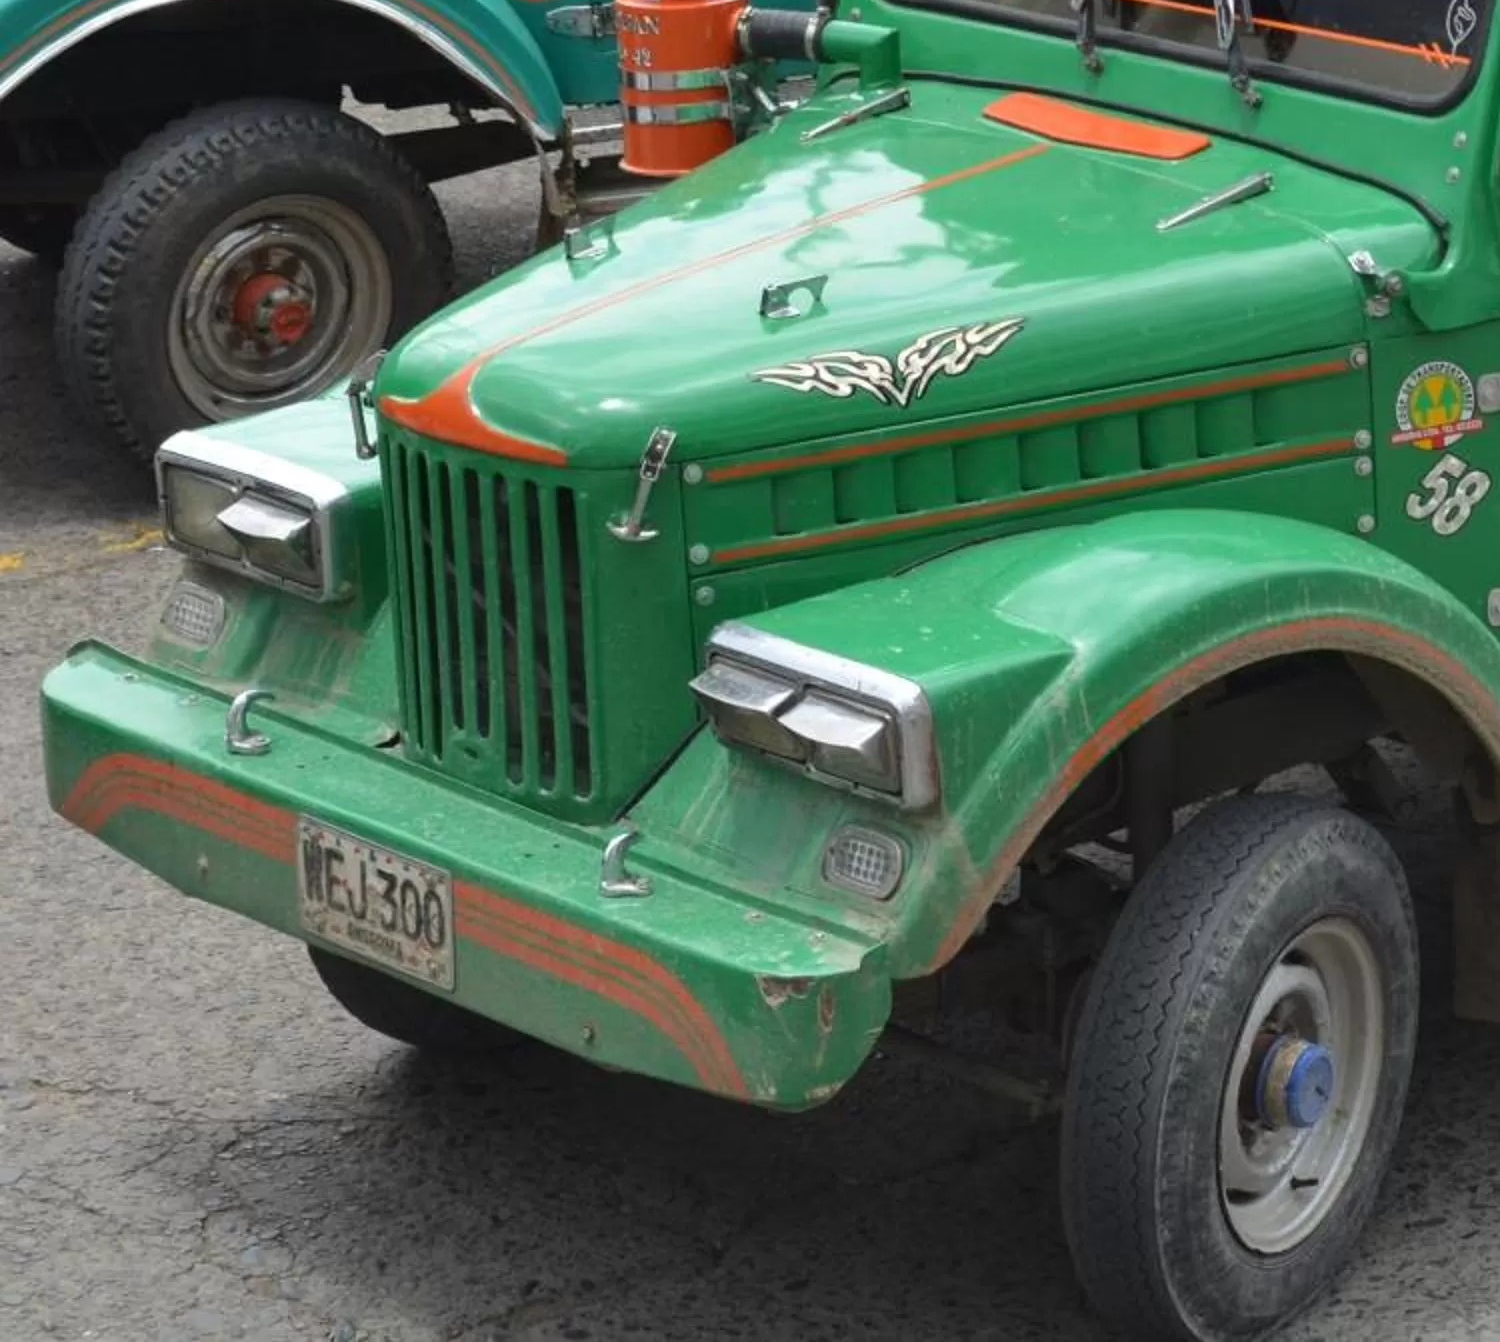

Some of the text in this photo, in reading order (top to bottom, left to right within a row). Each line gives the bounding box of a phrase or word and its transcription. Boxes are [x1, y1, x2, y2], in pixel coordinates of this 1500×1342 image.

[1405, 453, 1492, 536] 58
[303, 838, 445, 949] WEJ 300
